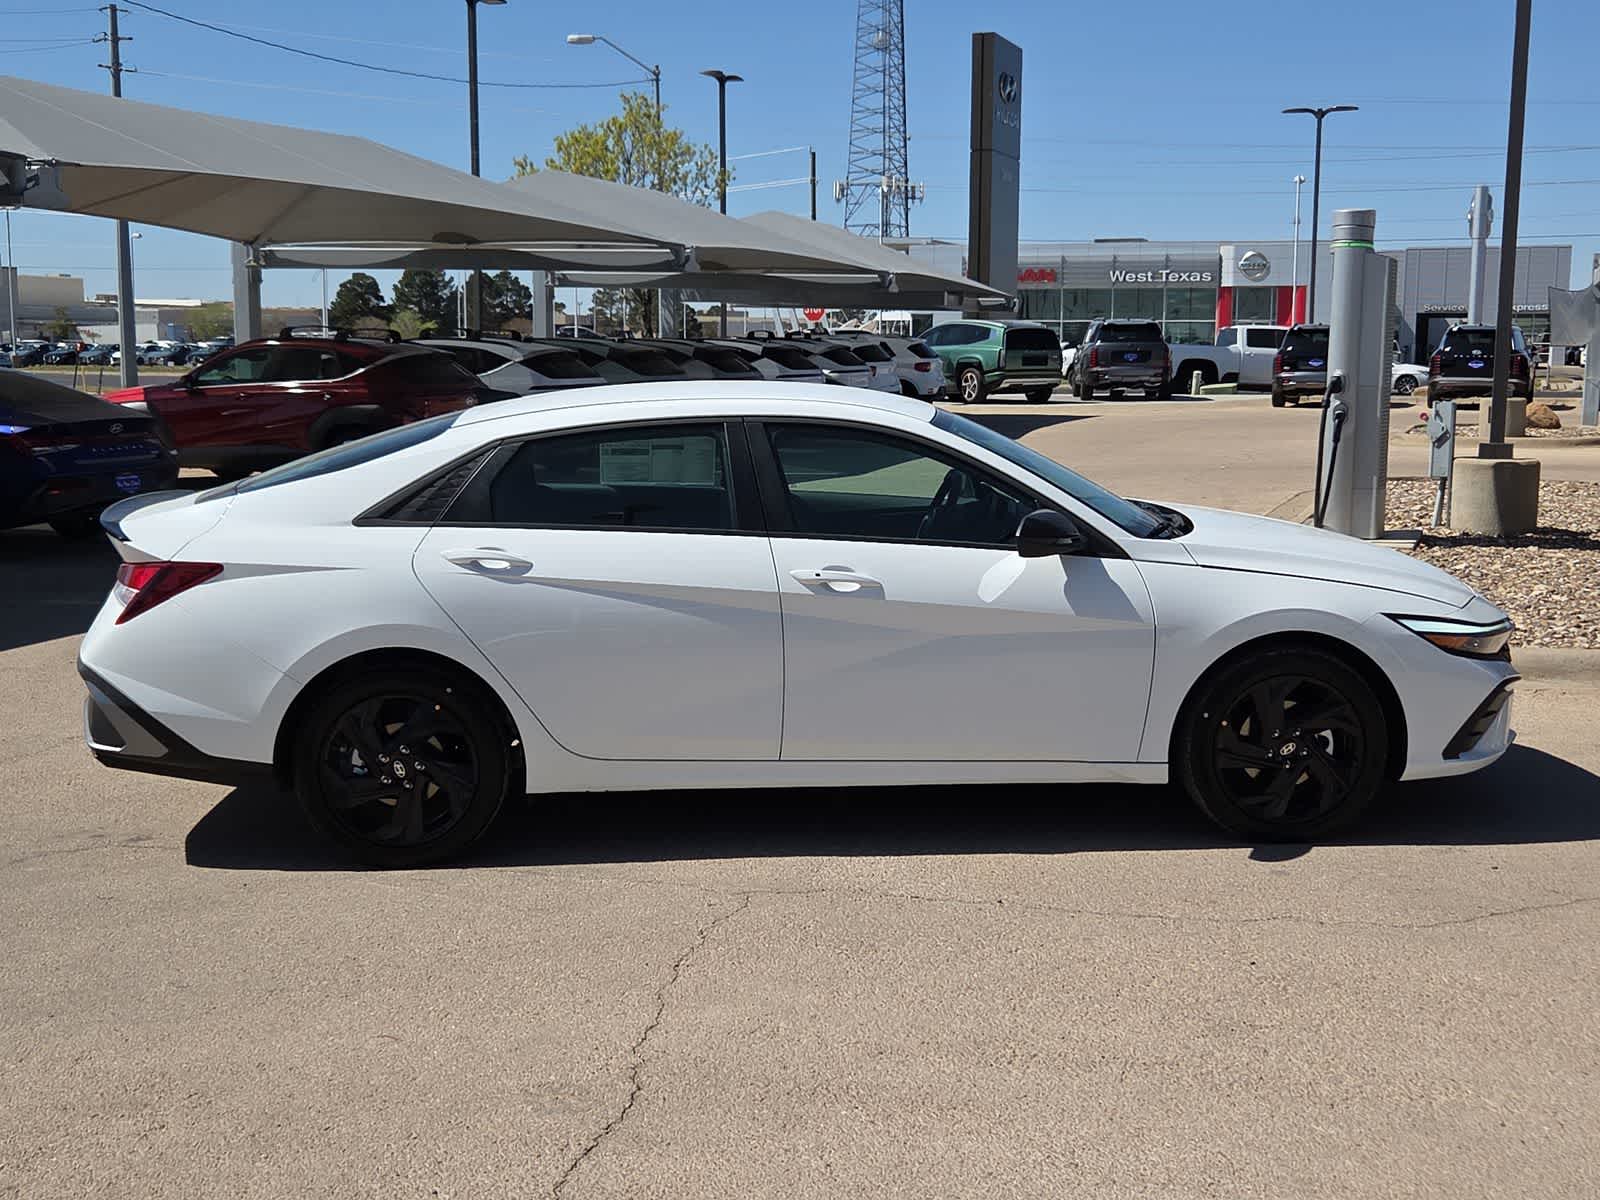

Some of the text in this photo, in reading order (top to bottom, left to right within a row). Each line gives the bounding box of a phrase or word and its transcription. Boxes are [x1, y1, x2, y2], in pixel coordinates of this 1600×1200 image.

[1110, 269, 1212, 282] West Texas
[1423, 303, 1466, 312] Service
